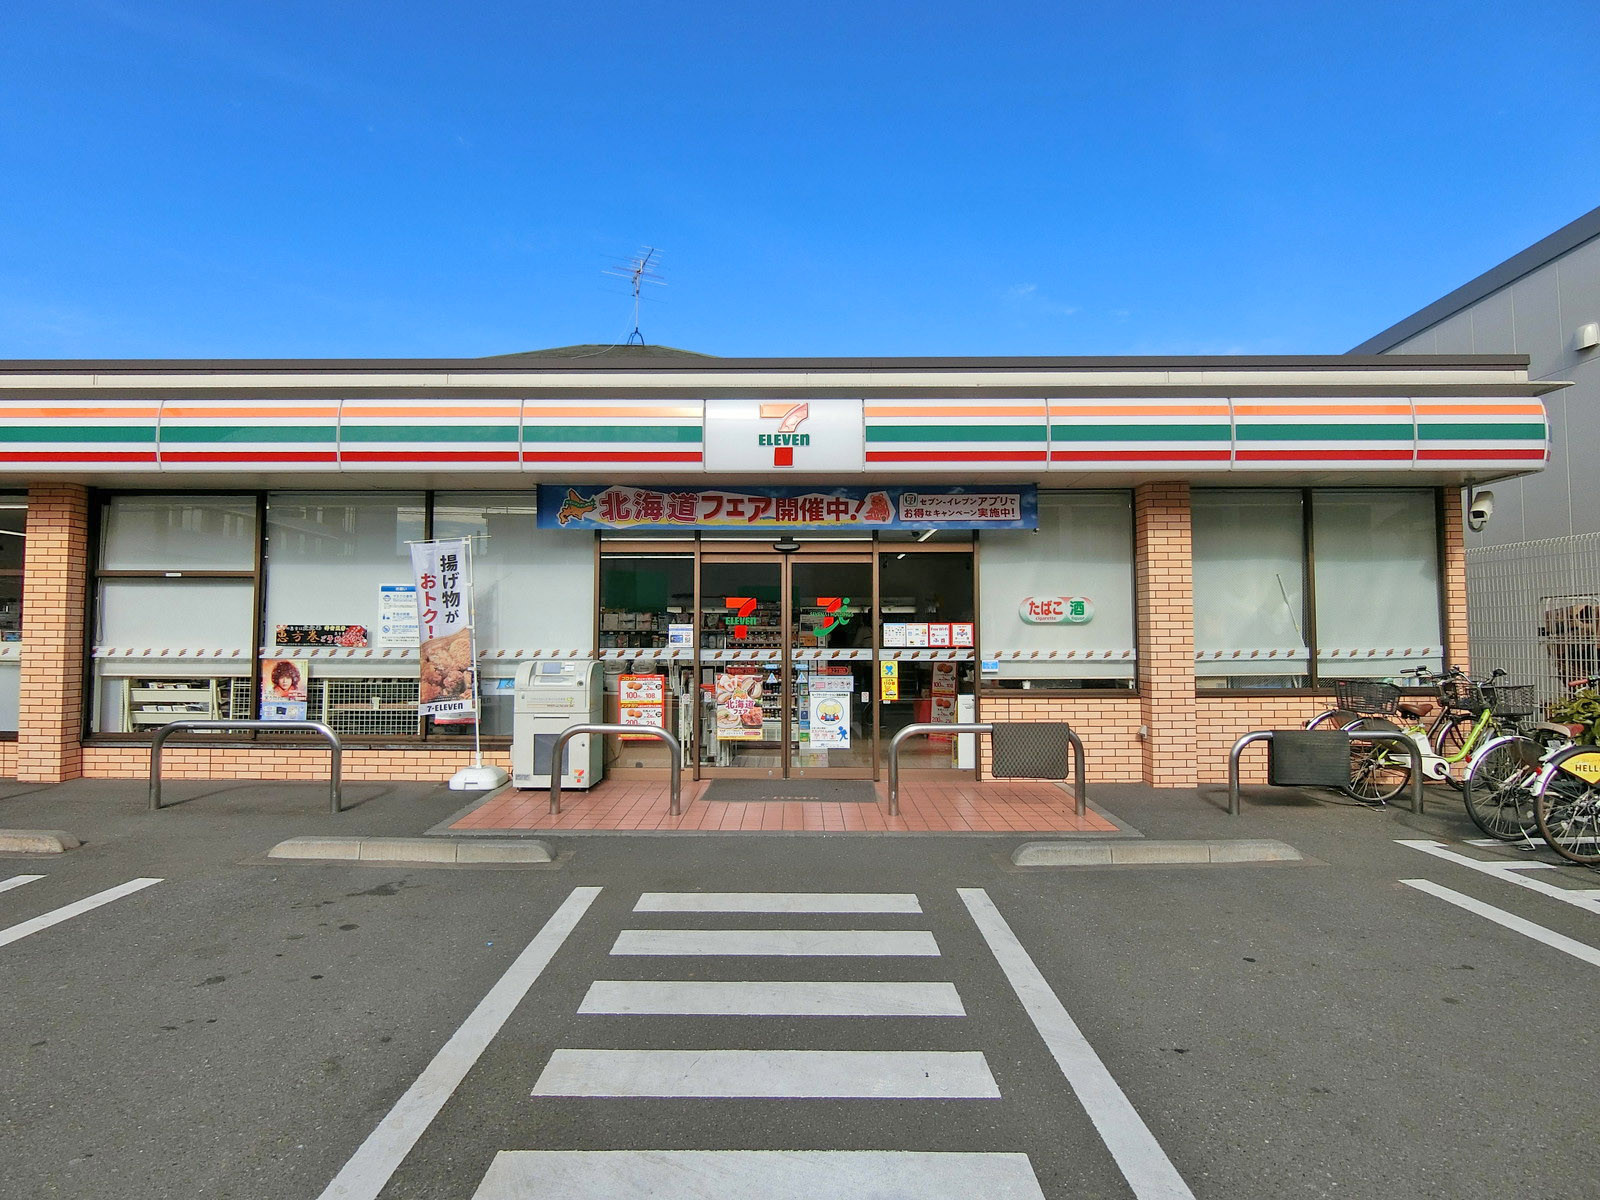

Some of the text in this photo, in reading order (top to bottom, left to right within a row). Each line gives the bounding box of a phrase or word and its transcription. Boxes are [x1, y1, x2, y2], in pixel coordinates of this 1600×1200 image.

[600, 490, 866, 523] 北海道フェア開催中!
[904, 508, 1016, 518] お得なキャンペーン実施中!
[440, 554, 461, 624] 揚げ物が
[420, 572, 439, 640] おトク!
[1028, 600, 1085, 616] たばこ 酒
